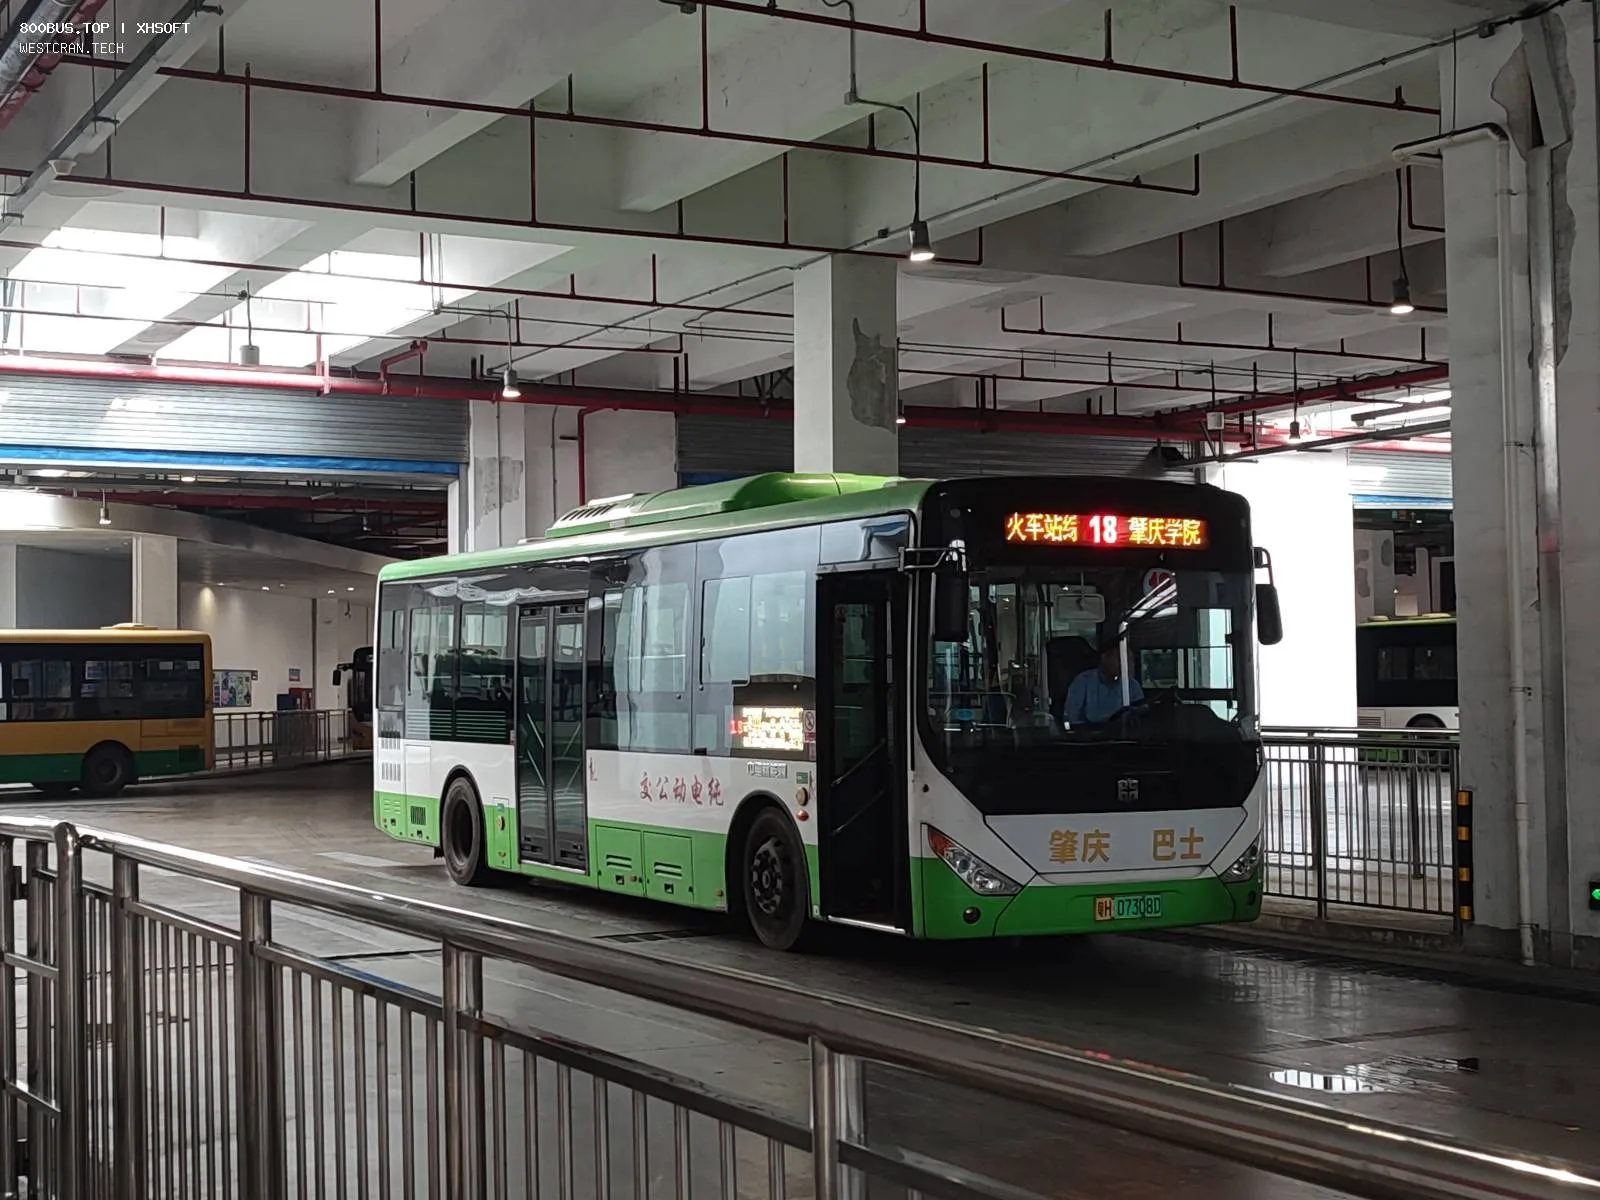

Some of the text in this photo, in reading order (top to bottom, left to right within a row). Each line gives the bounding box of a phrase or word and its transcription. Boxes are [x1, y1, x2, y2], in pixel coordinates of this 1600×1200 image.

[1089, 515, 1117, 544] 18
[1128, 516, 1201, 546] 肇庆学院
[1049, 827, 1205, 865] 肇庆 巴士
